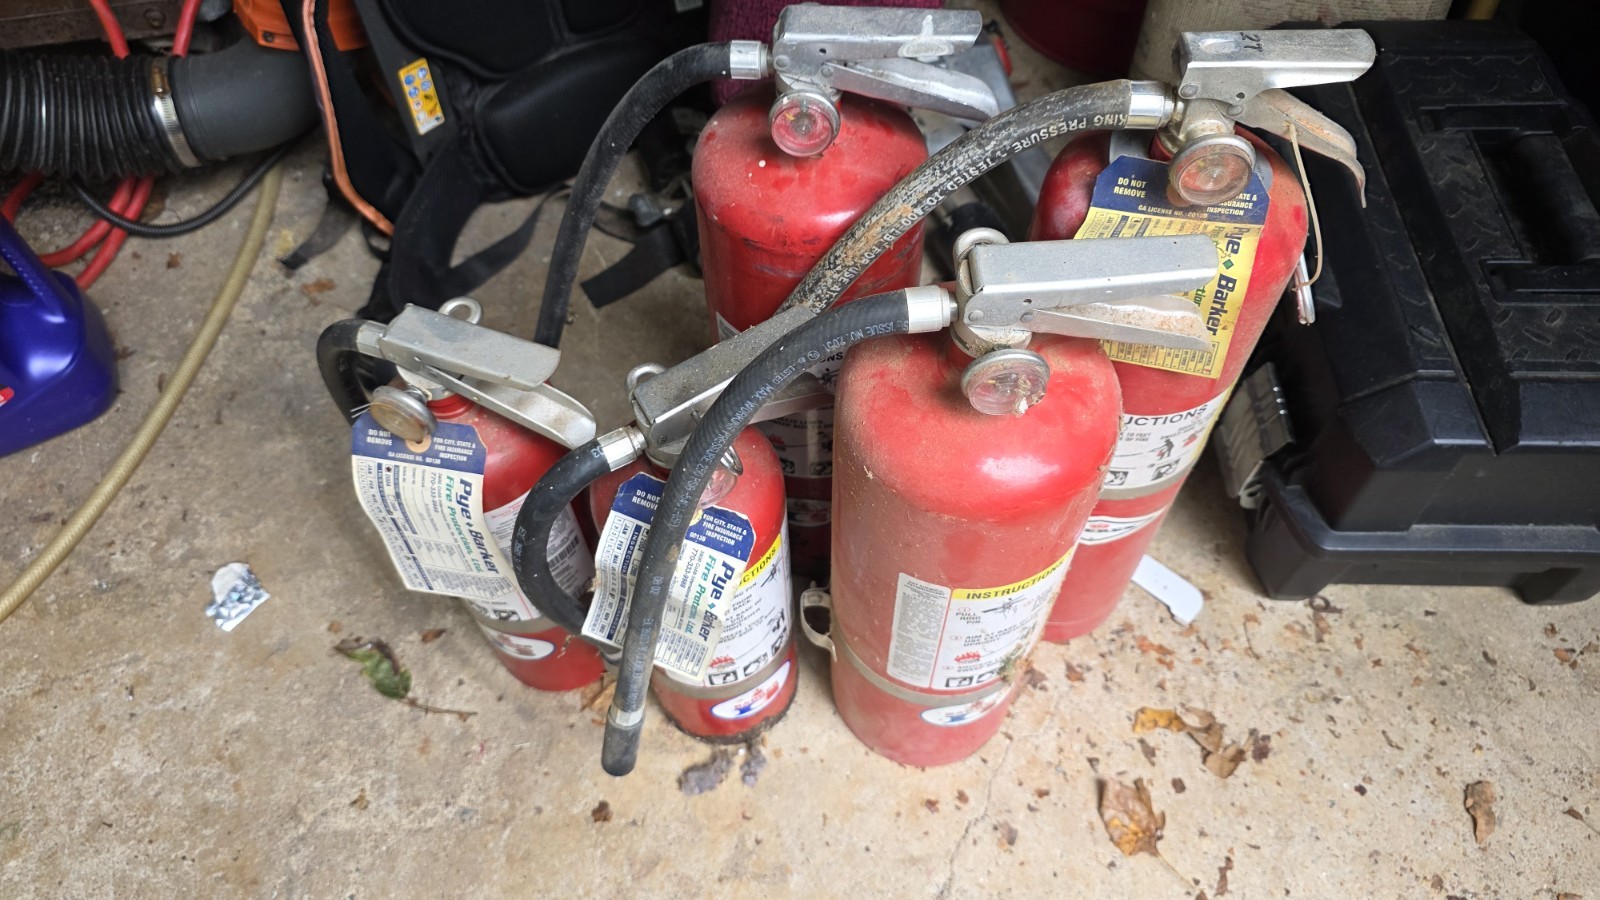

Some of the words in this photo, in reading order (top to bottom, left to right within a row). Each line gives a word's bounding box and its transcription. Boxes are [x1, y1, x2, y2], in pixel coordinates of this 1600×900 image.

[1012, 121, 1087, 154] PRESSURE
[948, 154, 997, 192] TESTED
[1118, 177, 1129, 186] DO
[1131, 179, 1147, 189] NOT
[1113, 186, 1147, 199] REMOVE
[1148, 205, 1173, 215] LICENSE
[1206, 207, 1245, 216] INSPECTION
[1219, 200, 1254, 209] SURANCE
[1224, 226, 1251, 255] Pye
[861, 245, 882, 265] FOR
[839, 266, 860, 285] USE
[1206, 273, 1238, 336] Barker
[846, 328, 864, 341] NO.
[864, 320, 895, 336] ISSUE
[822, 337, 847, 352] 2051
[752, 383, 775, 402] MAX.
[726, 399, 758, 431] WORKING
[366, 436, 393, 446] REMOVE
[368, 428, 378, 436] DO
[379, 429, 391, 438] NOT
[433, 436, 444, 445] FOR
[443, 438, 456, 447] CITY,
[456, 440, 472, 448] STATE
[434, 444, 446, 452] FIRE
[446, 446, 474, 456] INSURANCE
[700, 429, 730, 464] PRESSURE
[396, 452, 415, 461] LICENSE
[439, 452, 468, 462] INSPECTION
[693, 461, 708, 477] 250
[445, 475, 455, 502] Fire
[636, 489, 646, 498] DO
[646, 493, 661, 503] NOT
[456, 478, 473, 520] Pye
[469, 529, 500, 574] Barker
[621, 523, 631, 536] JAN
[702, 513, 714, 522] FOR
[713, 517, 726, 528] CITY,
[726, 522, 743, 533] STATE
[702, 521, 716, 530] FIRE
[715, 525, 743, 541] INSURANCE
[705, 529, 736, 546] INSPECTION
[616, 540, 625, 552] FEB
[620, 530, 640, 575] INSPECTION
[612, 554, 620, 565] MAR
[700, 554, 718, 582] Fire
[710, 560, 736, 601] Pye
[965, 559, 1065, 600] INSTRUCTIONS
[736, 607, 754, 617] BASE
[684, 620, 696, 634] Ltd.
[698, 610, 718, 642] Barker
